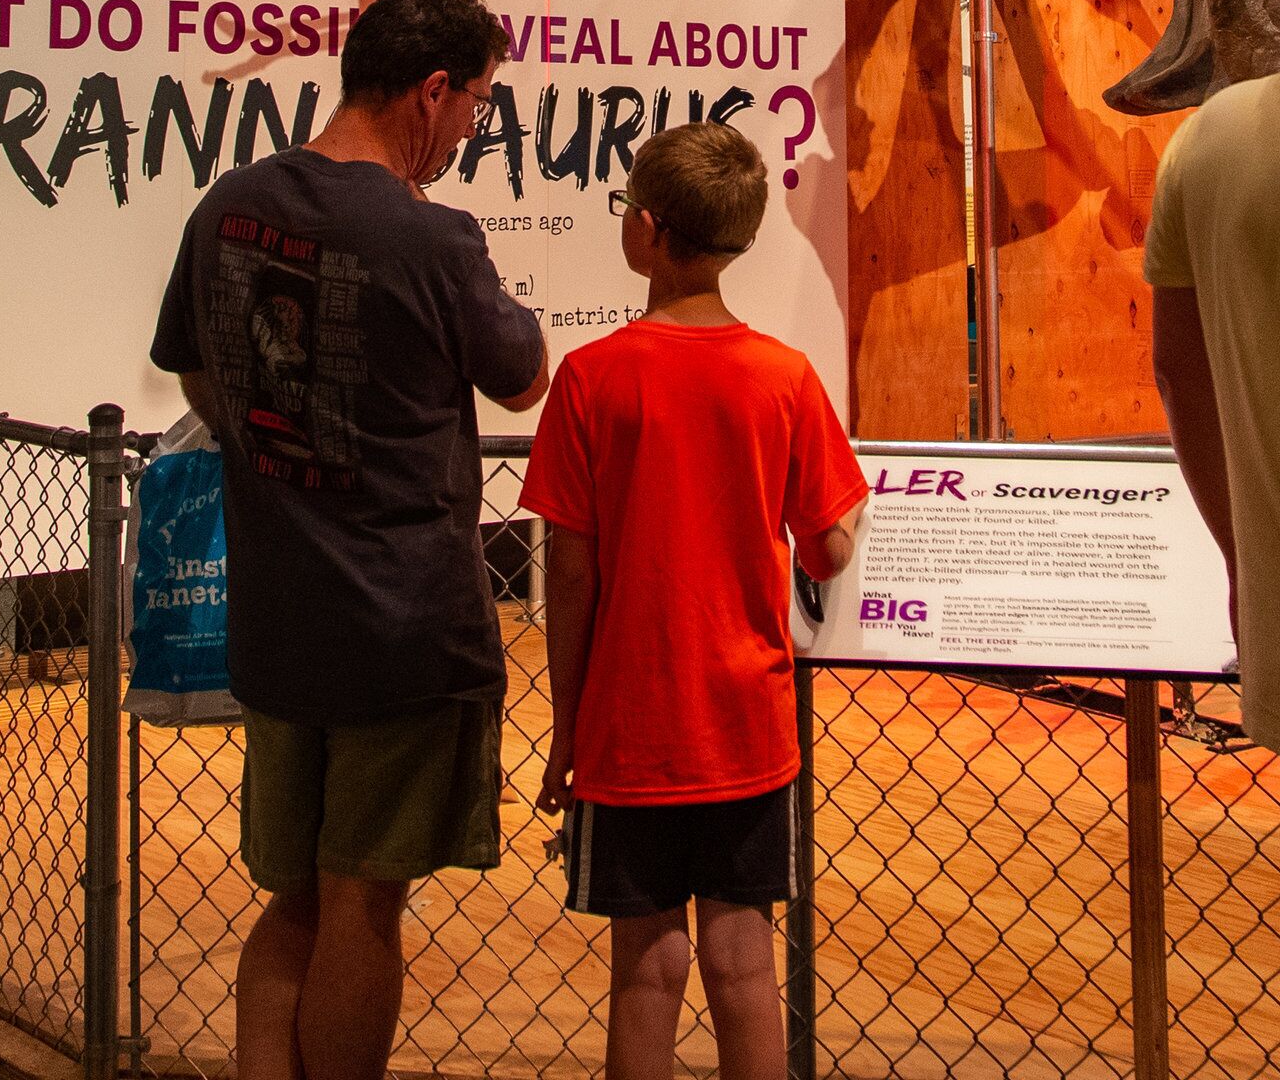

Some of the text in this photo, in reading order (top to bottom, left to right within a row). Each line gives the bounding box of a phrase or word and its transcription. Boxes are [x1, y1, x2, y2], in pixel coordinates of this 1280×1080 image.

[168, 0, 360, 58] FOSSI
[501, 14, 633, 66] VEAL
[647, 21, 808, 71] ABOUT
[221, 214, 258, 242] HATED
[261, 225, 280, 251] BY
[539, 215, 574, 236] ago
[515, 274, 534, 297] m)
[551, 306, 617, 327] metric
[624, 305, 649, 322] to
[872, 468, 1171, 505] LER or Scavenger?
[874, 504, 920, 513] Scientists
[946, 506, 970, 514] think
[1053, 509, 1070, 517] like
[873, 514, 909, 522] feasted
[926, 515, 970, 523] whatever
[984, 516, 1012, 524] found
[900, 527, 910, 535] of
[931, 528, 957, 536] fossil
[960, 529, 989, 537] bones
[1018, 530, 1035, 538] the
[1060, 531, 1089, 539] Creek
[1092, 532, 1129, 542] deposit
[1133, 533, 1156, 541] have
[870, 536, 896, 544] tooth
[899, 536, 929, 544] marks
[932, 537, 955, 545] from
[1027, 540, 1081, 550] impossible
[1084, 541, 1094, 549] to
[1097, 542, 1124, 550] know
[1127, 542, 1169, 551] whether
[887, 546, 926, 554] animals
[955, 548, 983, 556] taken
[1115, 552, 1151, 560] broken
[974, 558, 1028, 566] discovered
[1052, 560, 1086, 568] healed
[1089, 561, 1124, 569] wound
[1142, 562, 1159, 570] the
[864, 574, 888, 582] went
[892, 575, 915, 583] after
[918, 576, 936, 584] live
[884, 565, 895, 573] of
[905, 566, 962, 574] duck-billed
[1055, 570, 1075, 579] sign
[1078, 570, 1099, 578] that
[1122, 572, 1166, 580] dinosaur
[863, 591, 893, 599] What
[859, 599, 928, 623] BIG
[859, 622, 917, 631] TEETH You
[902, 631, 934, 639] Have!
